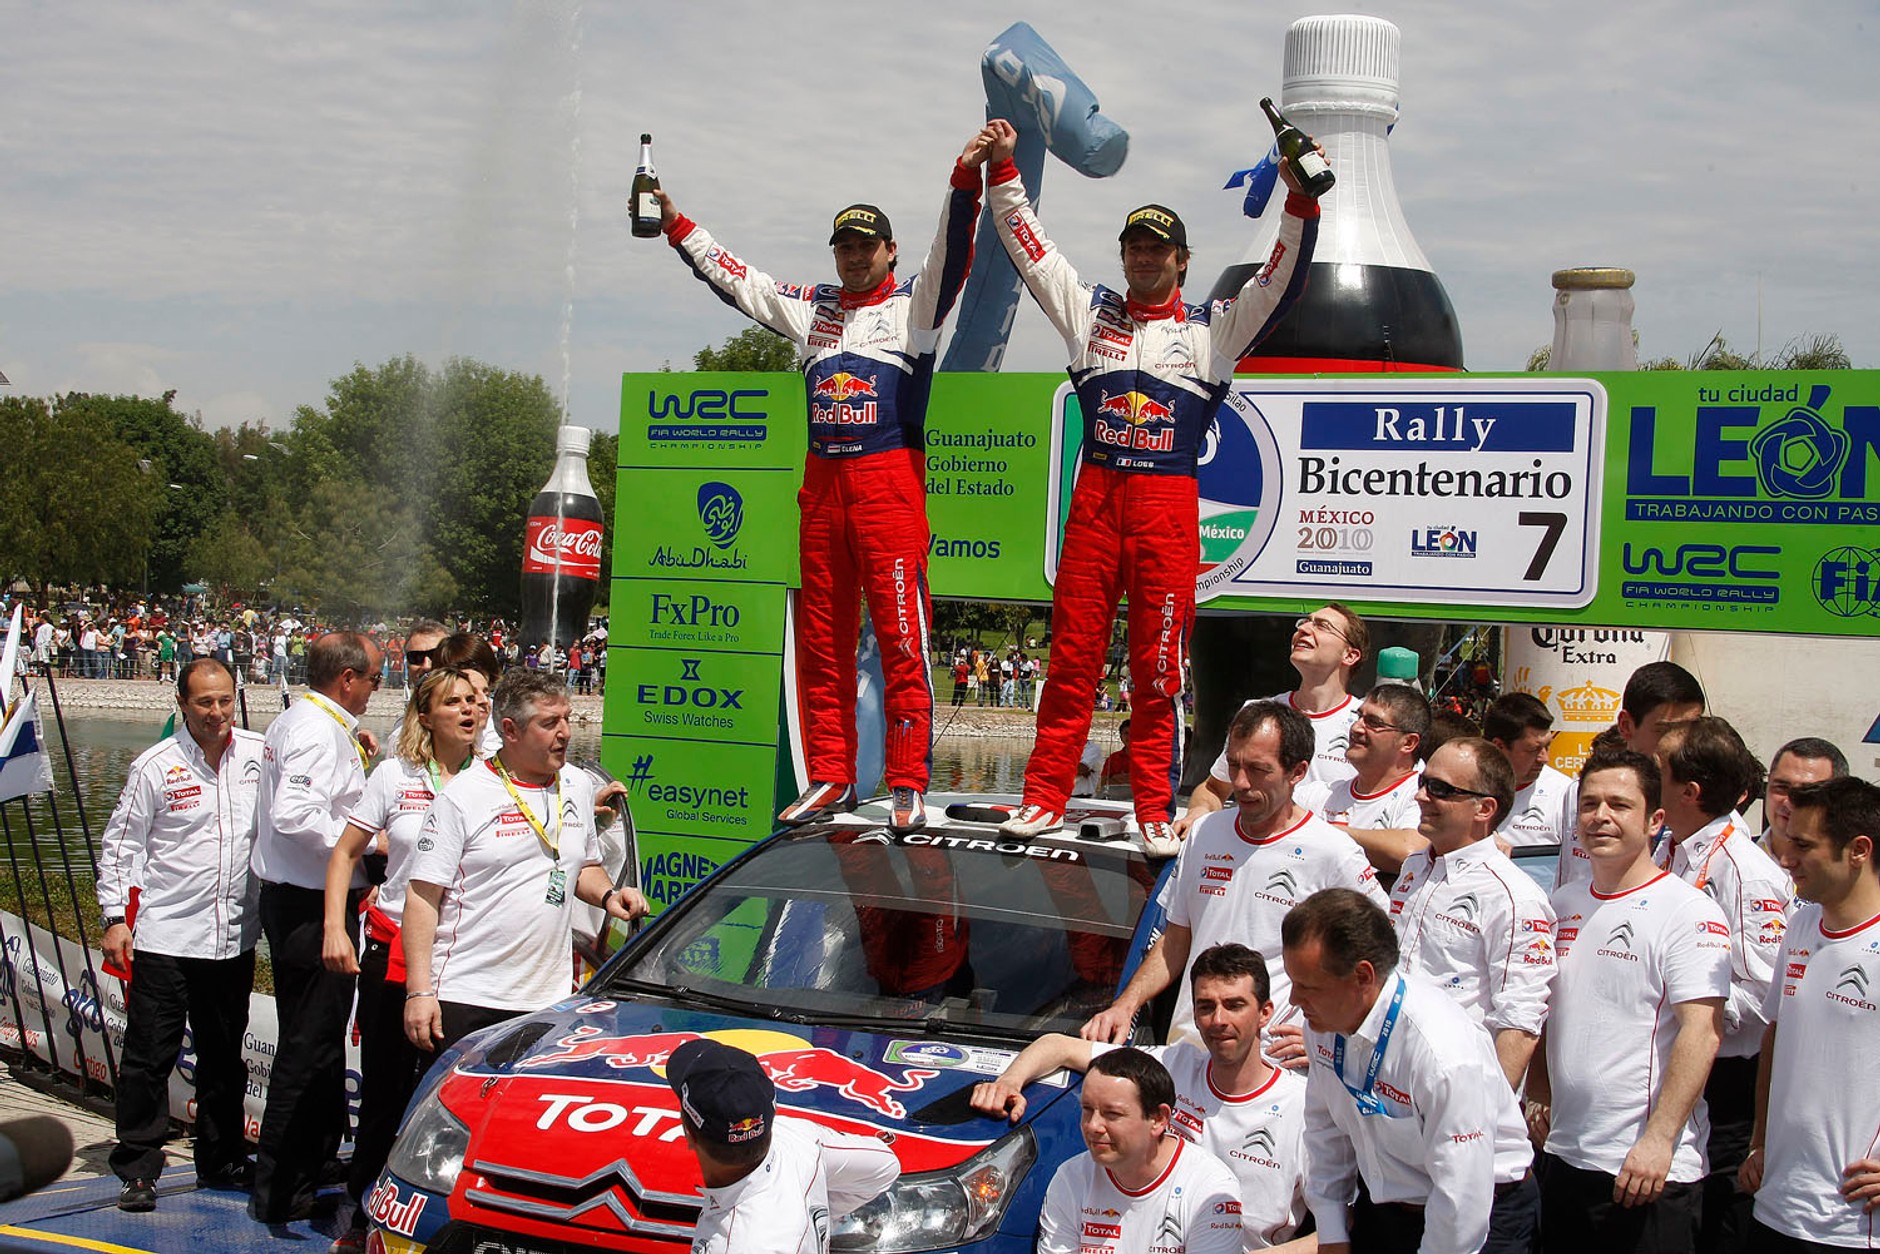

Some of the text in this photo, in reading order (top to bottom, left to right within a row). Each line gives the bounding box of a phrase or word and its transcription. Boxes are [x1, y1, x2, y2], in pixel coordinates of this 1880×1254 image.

[1020, 226, 1043, 260] TOTAL
[721, 252, 746, 276] TOTAL
[818, 324, 843, 335] TOTAL
[1102, 328, 1132, 345] TOTAL
[1225, 390, 1247, 413] Silao
[1699, 384, 1799, 402] tu ciudad
[649, 389, 769, 419] WRC
[812, 401, 879, 425] Red Bull
[672, 429, 717, 437] WORLD
[719, 429, 764, 438] RALLY
[1094, 419, 1175, 452] Red Bull
[1372, 405, 1497, 452] Rally
[925, 428, 1037, 452] Guanajuato
[926, 455, 1008, 474] Gobierno
[925, 477, 1015, 498] del Estado
[1297, 456, 1573, 499] Bicentenario
[1298, 504, 1375, 525] MÉXICO
[1635, 503, 1879, 522] TRABAJANDO CON PAS
[537, 524, 603, 559] Coca-Col
[1199, 524, 1245, 541] México
[1297, 526, 1374, 551] 2010
[1412, 526, 1477, 553] LEÓN
[1518, 511, 1569, 582] 7
[1299, 561, 1370, 576] Guanajuato
[1623, 542, 1782, 580] WRC
[1195, 555, 1246, 592] mpionship
[893, 557, 909, 636] CITROËN
[1626, 585, 1776, 599] FIA WORLD RALLY
[650, 593, 740, 628] FxPro
[1625, 602, 1775, 613] CHAMPIONSHIP
[650, 629, 671, 639] Trade
[673, 630, 696, 642] Forex
[697, 632, 716, 642] Like
[725, 633, 740, 643] Pro
[1157, 592, 1176, 674] CITROËN
[1562, 646, 1617, 664] Extra
[637, 684, 745, 710] EDOX
[644, 710, 734, 728] Swiss Watches
[175, 788, 201, 798] TOTAL
[406, 791, 435, 799] TOTAL
[666, 809, 748, 826] Global Services
[1513, 823, 1551, 832] CITROËN
[1208, 869, 1232, 879] TOTAL
[1434, 912, 1481, 934] CITROËN
[1759, 934, 1775, 945] Red
[1523, 954, 1541, 966] Red
[1597, 948, 1639, 963] CITROËN
[1825, 990, 1877, 1012] CITROËN
[244, 1032, 276, 1057] Guan
[1316, 1044, 1335, 1061] TOTA
[1178, 1112, 1203, 1132] TOTAL
[729, 1131, 748, 1144] Red
[1452, 1130, 1485, 1144] TOTAL
[1229, 1150, 1281, 1170] CITROËN
[374, 1183, 429, 1237] Bull
[1088, 1226, 1120, 1237] TOTAL
